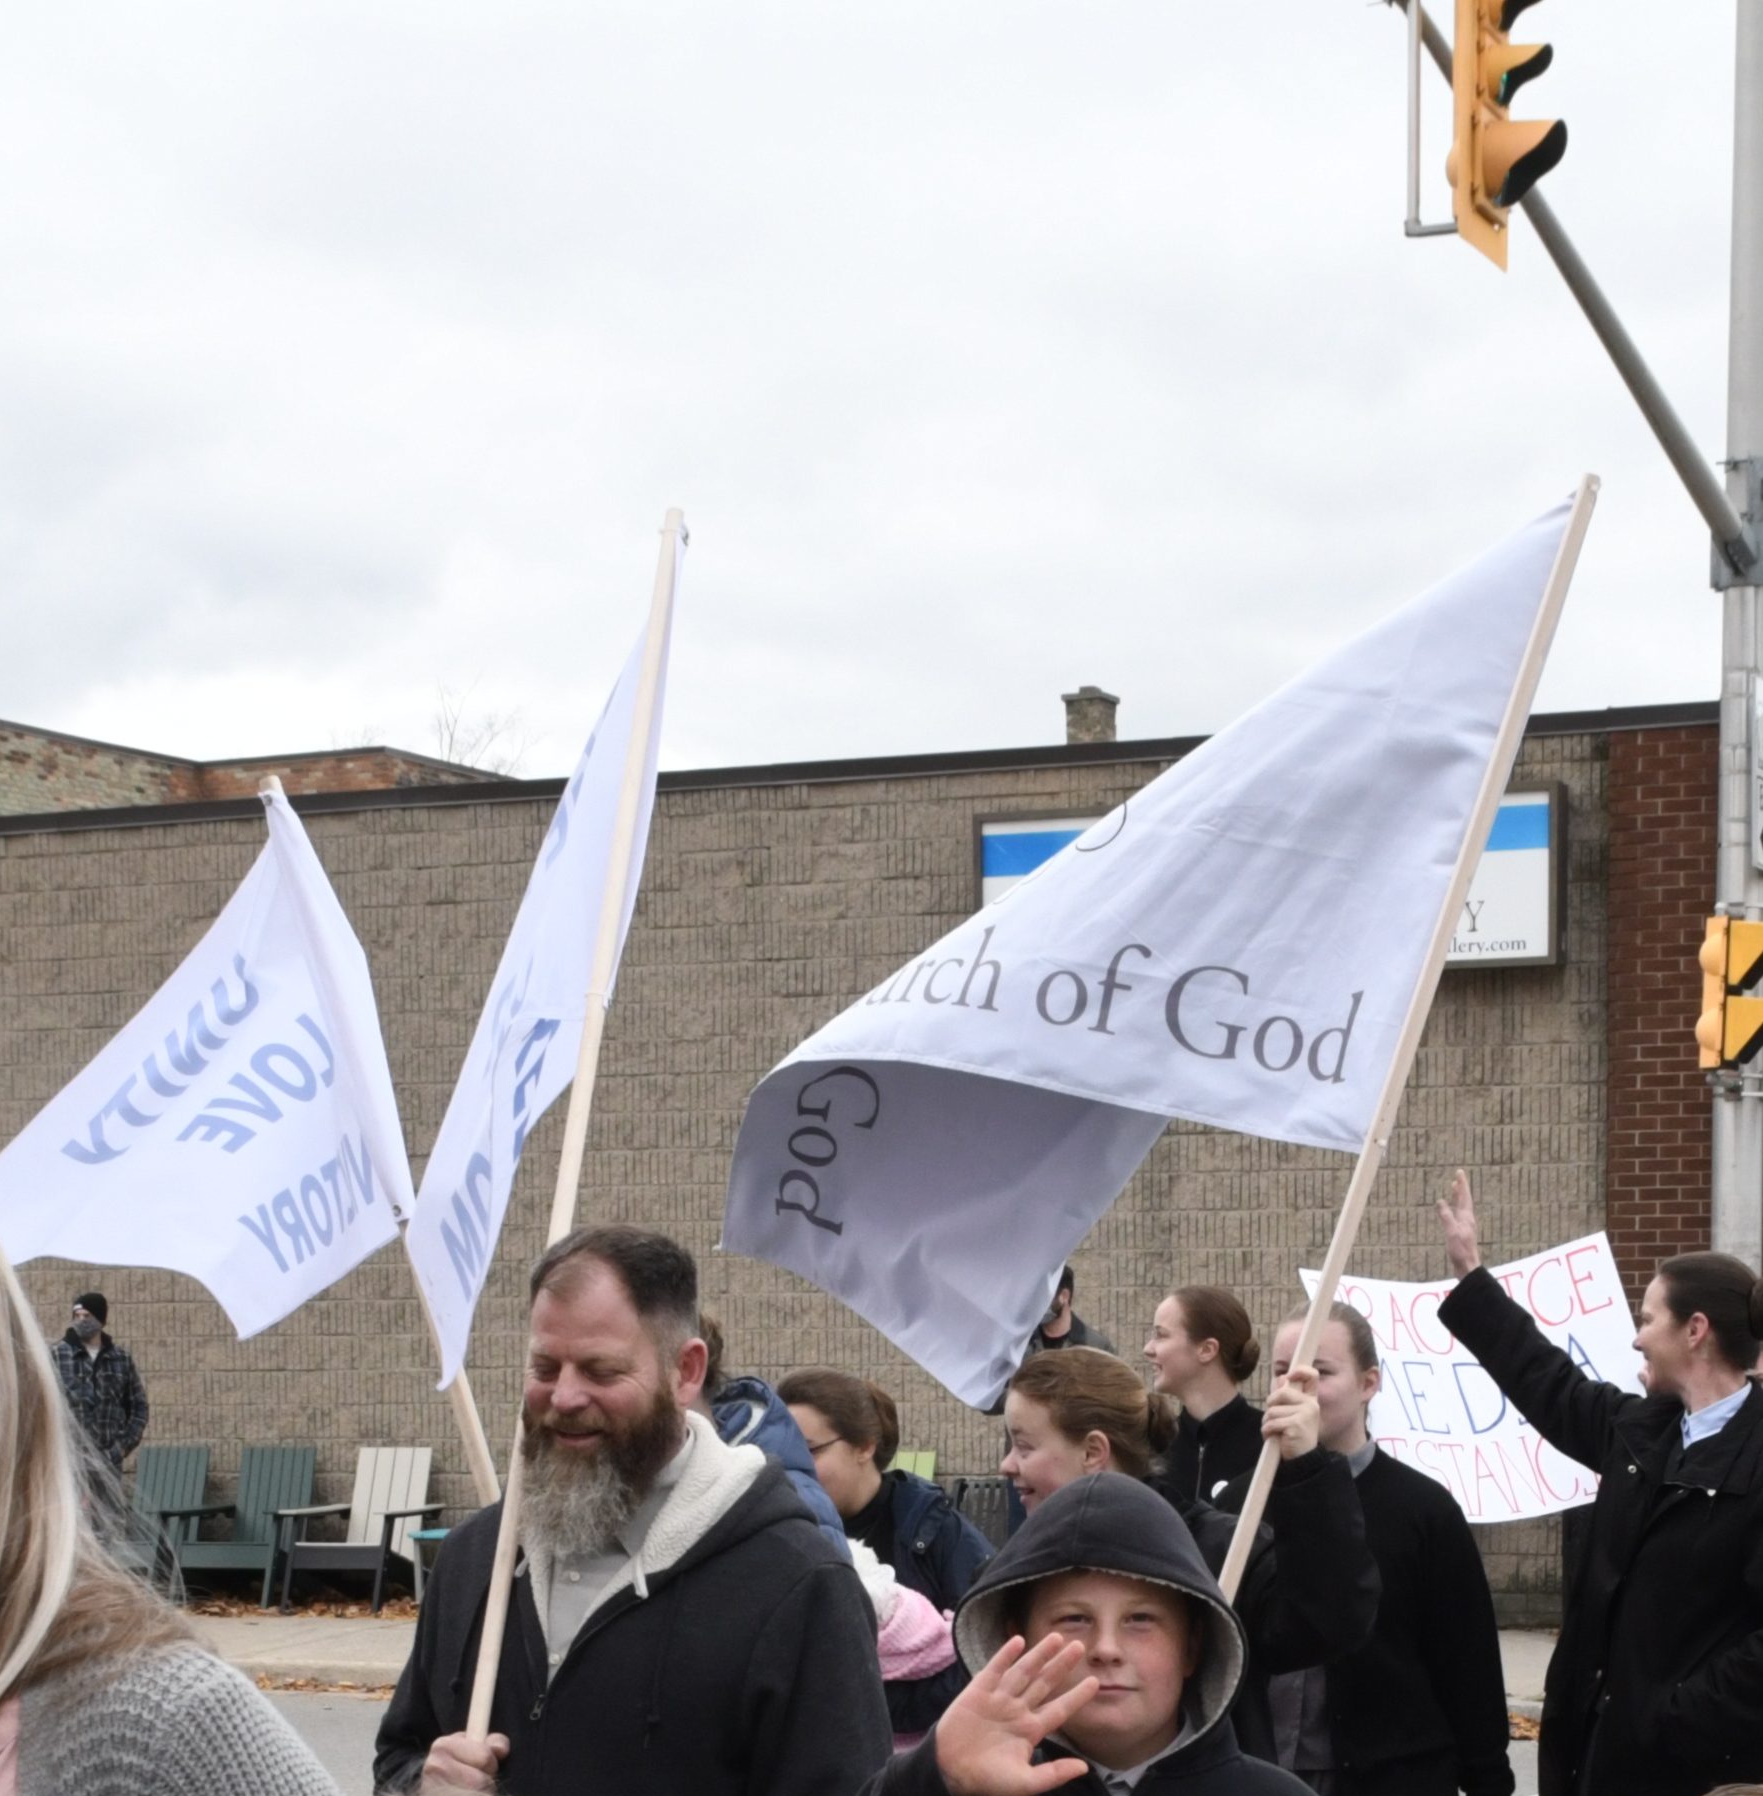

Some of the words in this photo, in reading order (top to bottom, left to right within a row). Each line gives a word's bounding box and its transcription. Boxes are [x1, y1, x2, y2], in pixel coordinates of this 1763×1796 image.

[1036, 943, 1152, 1036] of
[1164, 966, 1365, 1085] God
[775, 1065, 880, 1237] God
